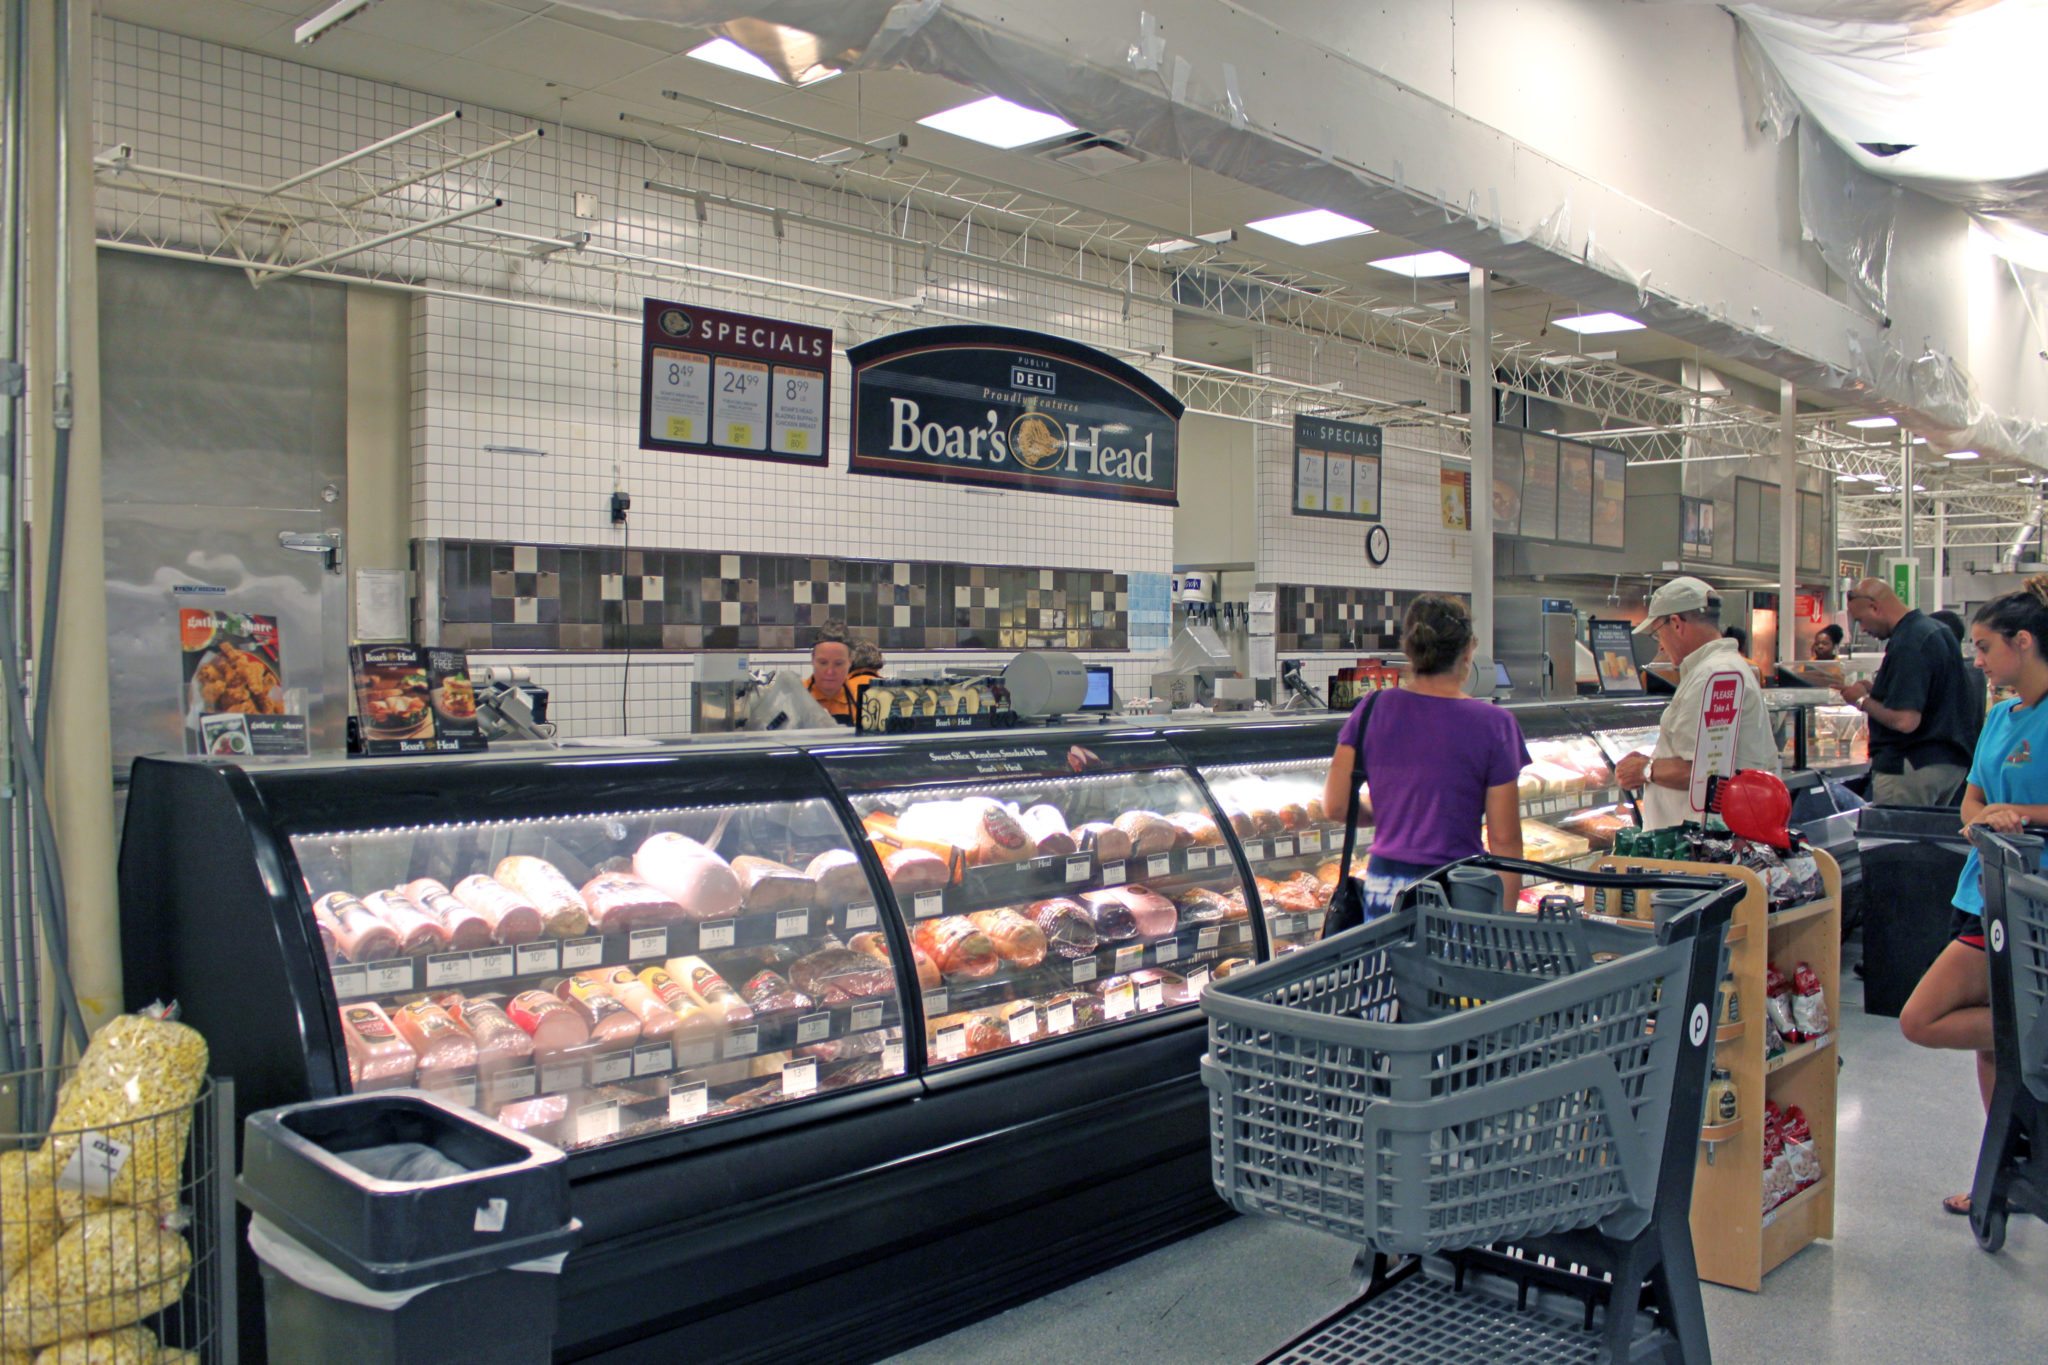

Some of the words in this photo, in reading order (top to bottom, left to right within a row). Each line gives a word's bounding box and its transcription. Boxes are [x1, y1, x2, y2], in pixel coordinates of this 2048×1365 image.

[701, 319, 823, 357] SPECIALS
[1018, 357, 1050, 368] PUBLIX
[1016, 372, 1051, 388] DELI
[983, 387, 1029, 406] Proudly
[1032, 395, 1079, 412] Features
[889, 397, 1006, 462] Boar's
[1064, 423, 1153, 483] Head
[1320, 425, 1378, 447] SPECIALS
[433, 659, 453, 669] FREE
[1713, 689, 1734, 699] PLEASE
[1713, 704, 1725, 713] Take
[1724, 703, 1730, 711] A
[1709, 718, 1729, 727] Number
[436, 739, 459, 750] Head
